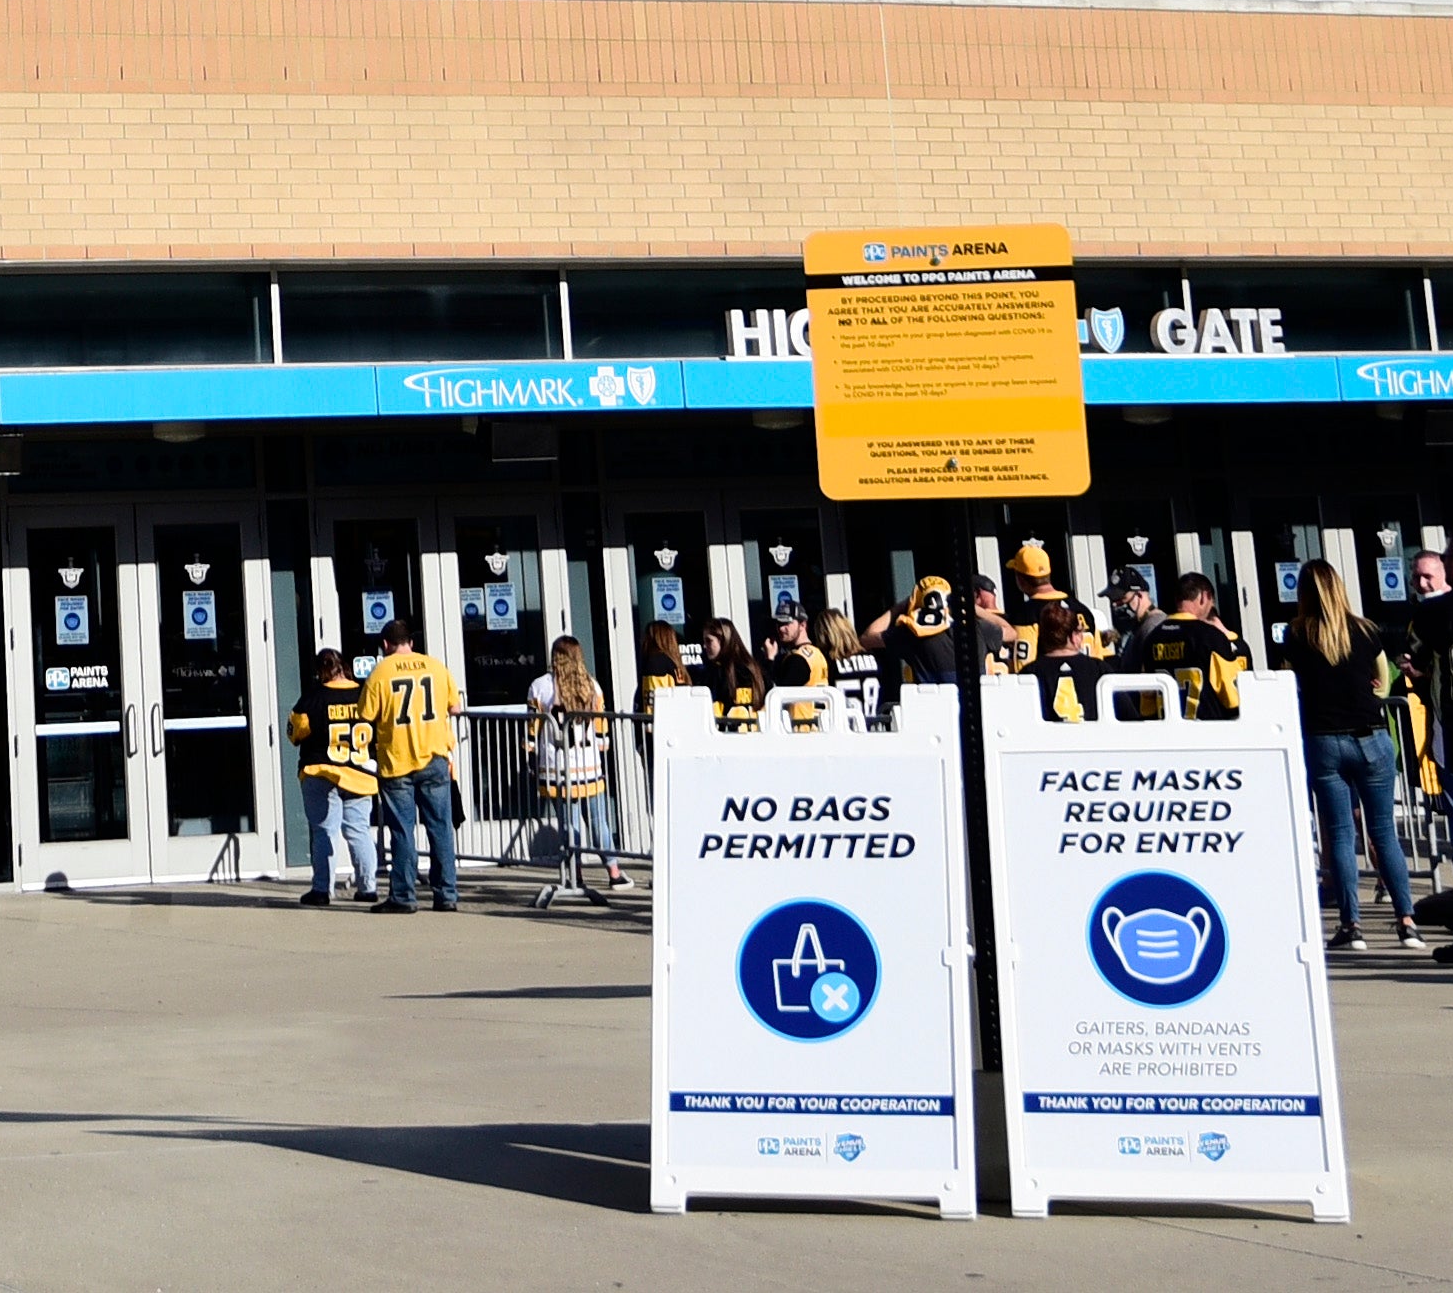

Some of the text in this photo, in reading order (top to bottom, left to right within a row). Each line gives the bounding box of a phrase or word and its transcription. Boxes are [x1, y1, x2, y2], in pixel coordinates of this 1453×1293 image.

[864, 241, 1009, 262] PPG PAINTS ARENA
[841, 269, 1035, 285] WELCOME TO PPG PAINTS ARENA
[840, 290, 1039, 305] BY PROCEEDING BEYOND THIS POINT, YOU
[827, 300, 1054, 315] AGREE THAT YOU ARE ACCURATELY ANSWERING
[837, 311, 1044, 327] NO TO ALL OF THE FOLLOWING QUESTIONS:
[1152, 307, 1286, 355] GATE
[409, 371, 577, 407] HIGHMARK
[1151, 641, 1187, 661] CROSBY
[395, 661, 427, 672] MALKIN
[46, 665, 109, 690] PPG PAINTS
[71, 677, 109, 689] ARENA
[391, 676, 436, 725] 71
[327, 722, 373, 765] 59
[1039, 769, 1243, 792] FACE MASKS
[721, 795, 892, 822] NO BAGS
[1064, 800, 1232, 823] REQUIRED
[698, 833, 916, 859] PERMITTED
[1058, 831, 1244, 854] FOR ENTRY
[1075, 1021, 1251, 1037] GAITERS, BANDANAS
[1068, 1041, 1262, 1057] OR MASKS WITH VENTS
[1099, 1062, 1237, 1077] ARE PROHIBITED
[684, 1095, 940, 1112] THANK YOU FOR YOUR COOPERATION
[1038, 1095, 1306, 1113] THANK YOU FOR YOUR COOPERATION
[783, 1137, 821, 1147] PAINTS
[1144, 1136, 1185, 1147] PAINTS
[783, 1147, 821, 1157] ARENA
[1146, 1146, 1185, 1157] ARENA
